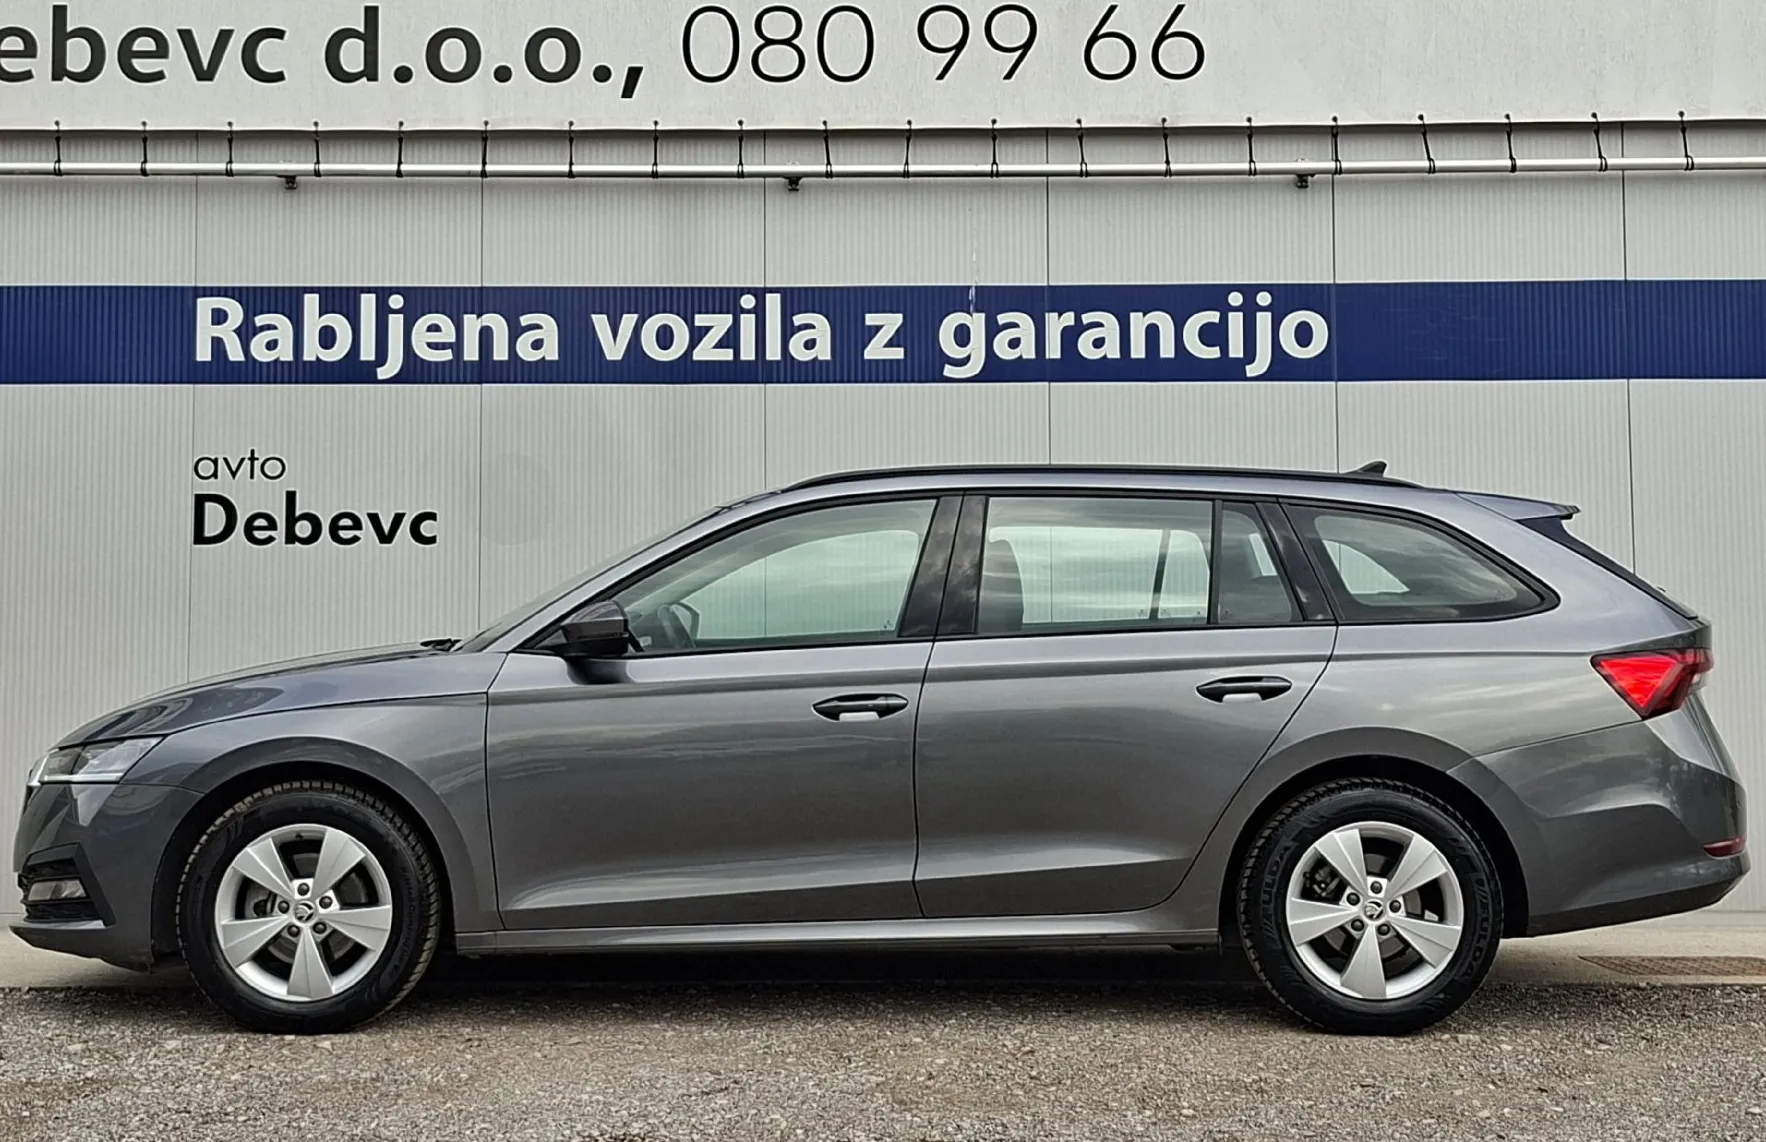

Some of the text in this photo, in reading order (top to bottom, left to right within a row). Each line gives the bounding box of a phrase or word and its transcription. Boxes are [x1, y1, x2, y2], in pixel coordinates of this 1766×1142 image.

[325, 5, 644, 99] d.o.o.,
[683, 5, 874, 84] 080
[917, 4, 1038, 81] 99
[1084, 4, 1205, 81] 66
[195, 291, 1329, 380] Rabljena vozila z garancijo
[193, 448, 287, 481] avto
[192, 489, 438, 546] Debevc
